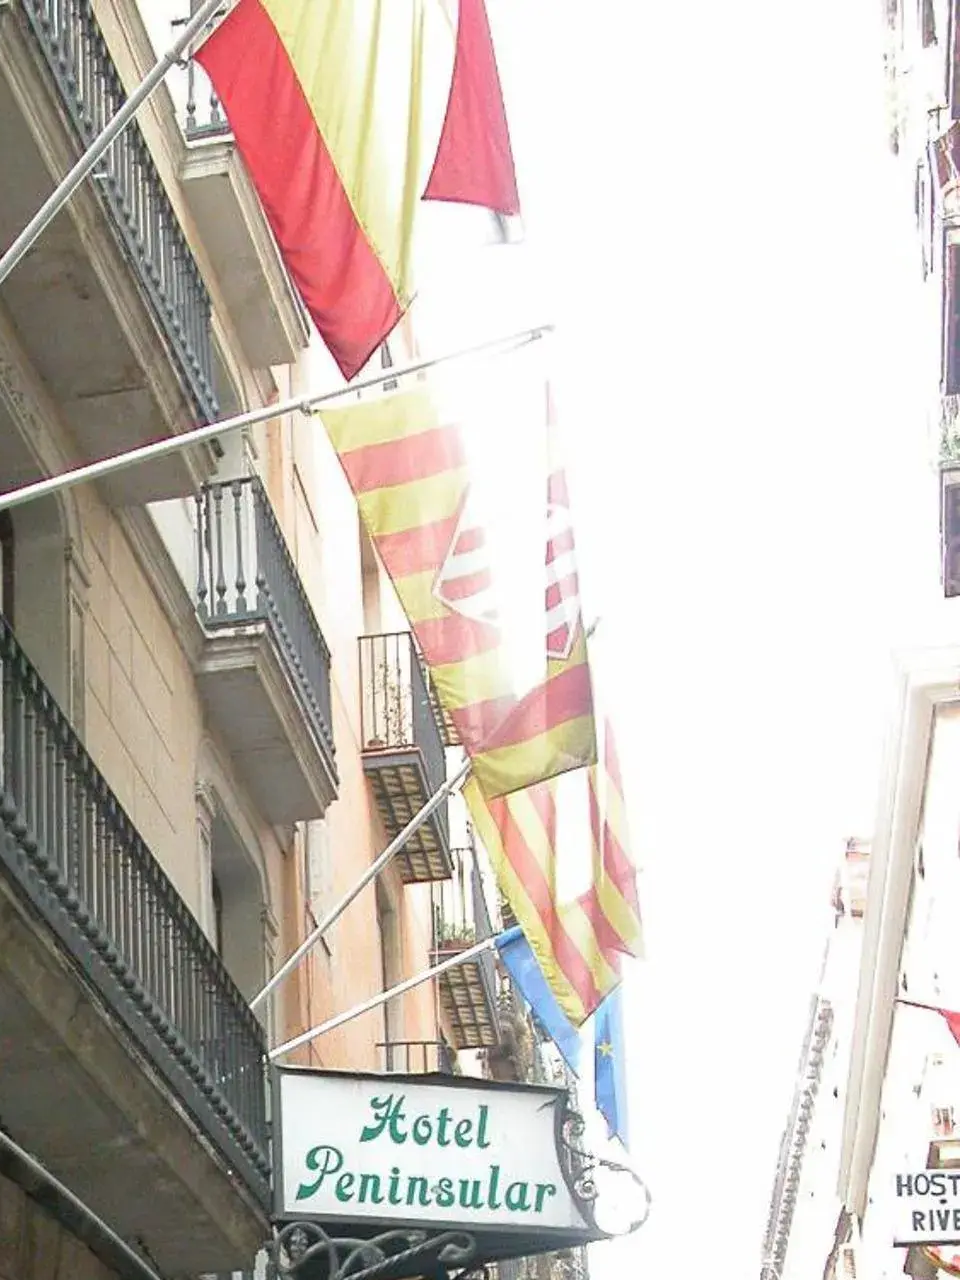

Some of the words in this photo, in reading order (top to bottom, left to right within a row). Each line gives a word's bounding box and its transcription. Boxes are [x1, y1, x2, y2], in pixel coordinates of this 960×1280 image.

[359, 1094, 491, 1149] Hotel
[295, 1145, 556, 1213] Peninsular
[896, 1174, 960, 1196] HOST
